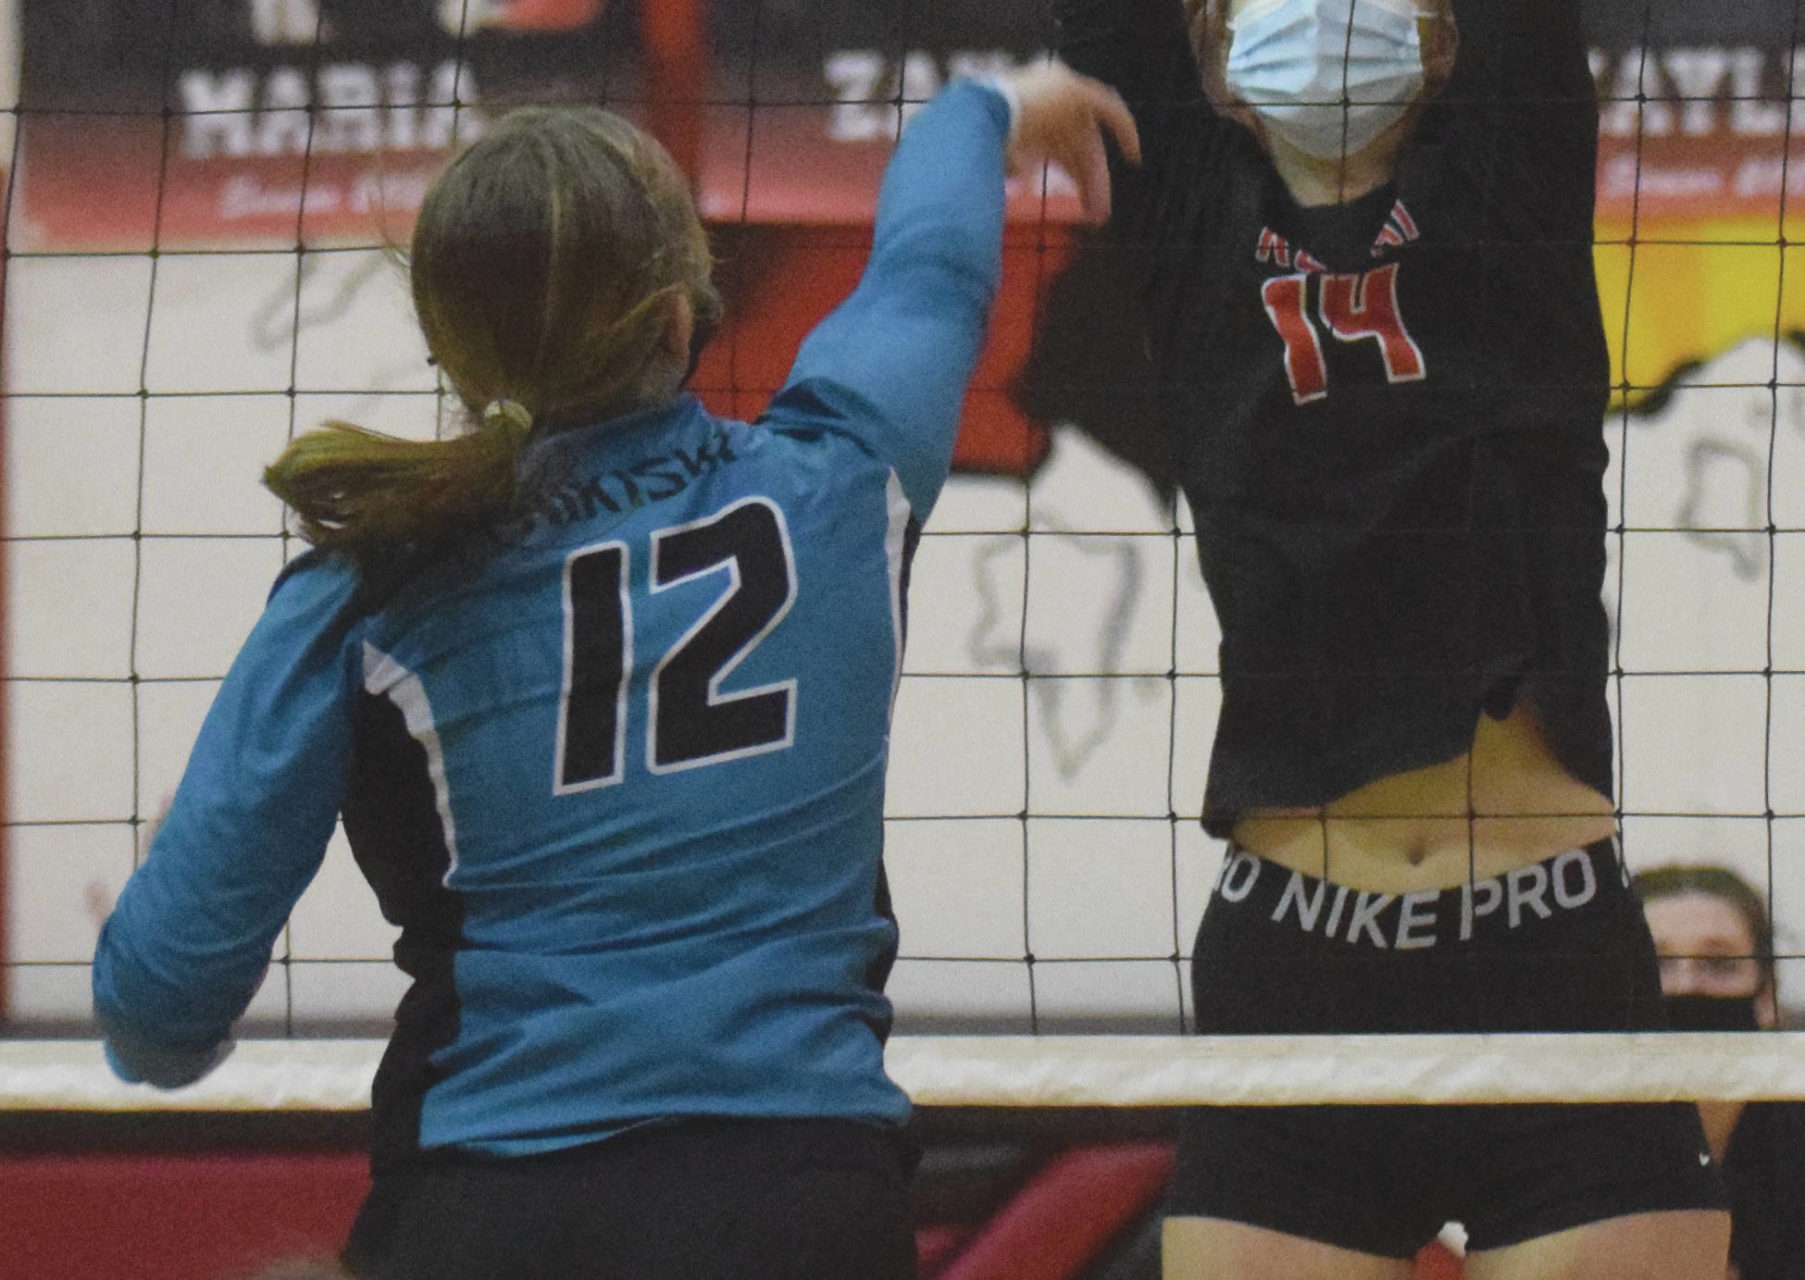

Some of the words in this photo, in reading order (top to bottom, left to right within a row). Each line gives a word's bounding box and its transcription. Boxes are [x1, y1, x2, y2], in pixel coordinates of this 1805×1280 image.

[1260, 261, 1427, 406] 14
[552, 495, 799, 796] 12
[1271, 871, 1441, 950] NIKE
[1459, 847, 1597, 942] PRO
